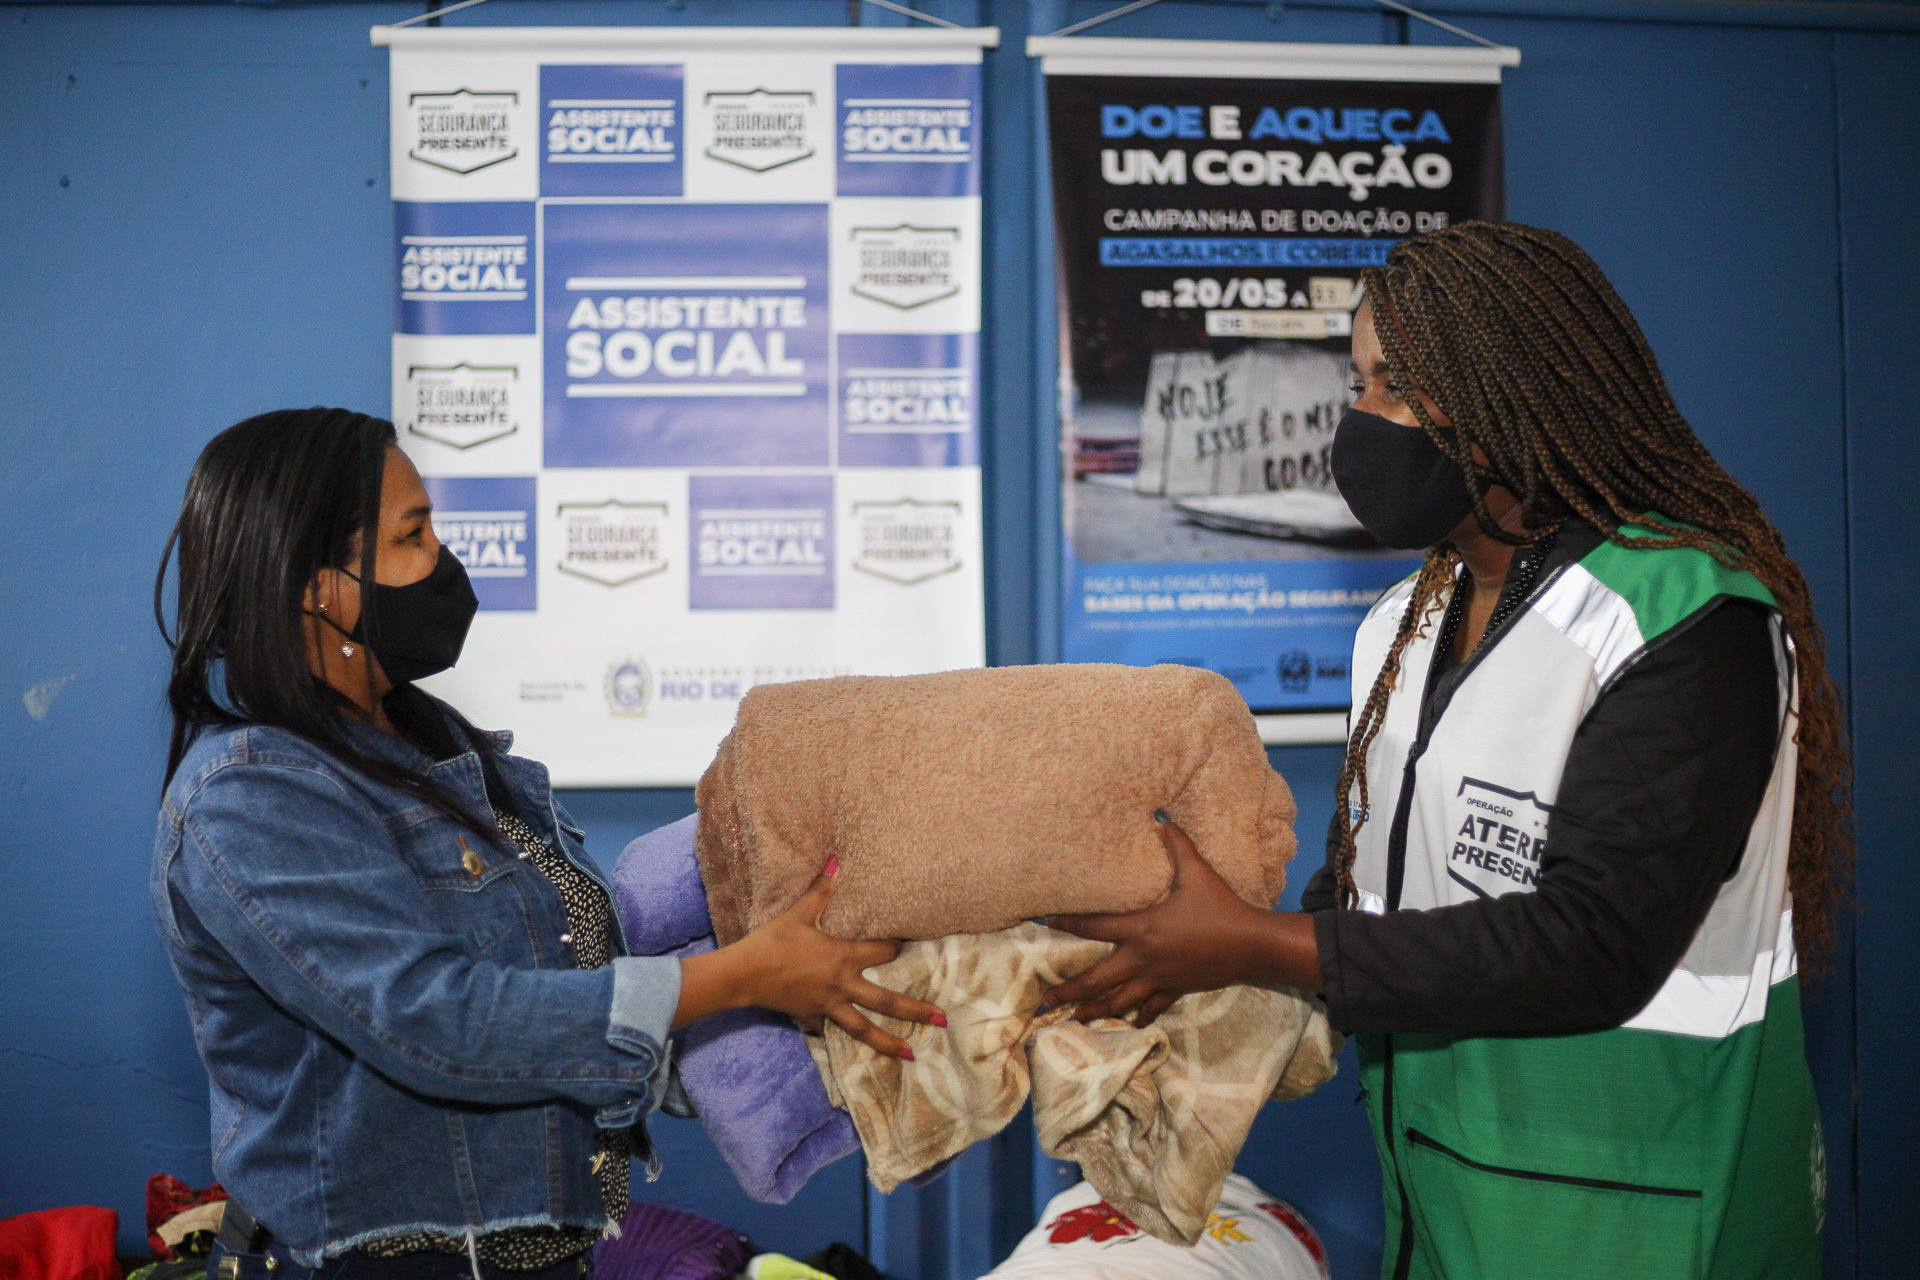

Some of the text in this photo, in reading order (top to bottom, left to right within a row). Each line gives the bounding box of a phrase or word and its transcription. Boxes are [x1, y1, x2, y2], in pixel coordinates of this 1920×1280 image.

[550, 109, 676, 128] ASSISTENTE
[844, 109, 972, 127] ASSISTENTE
[1101, 104, 1451, 146] DOE E AQUEÇA
[418, 134, 510, 151] PRESENTE
[548, 127, 675, 153] SOCIAL
[843, 126, 971, 153] SOCIAL
[1101, 144, 1453, 202] UM CORAÇÃO
[1103, 208, 1450, 237] CAMPANHA DE DOAÇÃO DE
[402, 246, 528, 265] ASSISTENTE
[1109, 242, 1261, 262] AGASALHOS
[401, 264, 527, 291] SOCIAL
[1141, 290, 1172, 308] DE
[1172, 277, 1288, 309] 20/05
[1290, 290, 1310, 308] A
[567, 296, 807, 330] ASSISTENTE
[565, 330, 806, 378] SOCIAL
[846, 397, 971, 424] SOCIAL
[697, 538, 826, 565] SOCIAL
[1466, 797, 1514, 818] OPERAÇÃO
